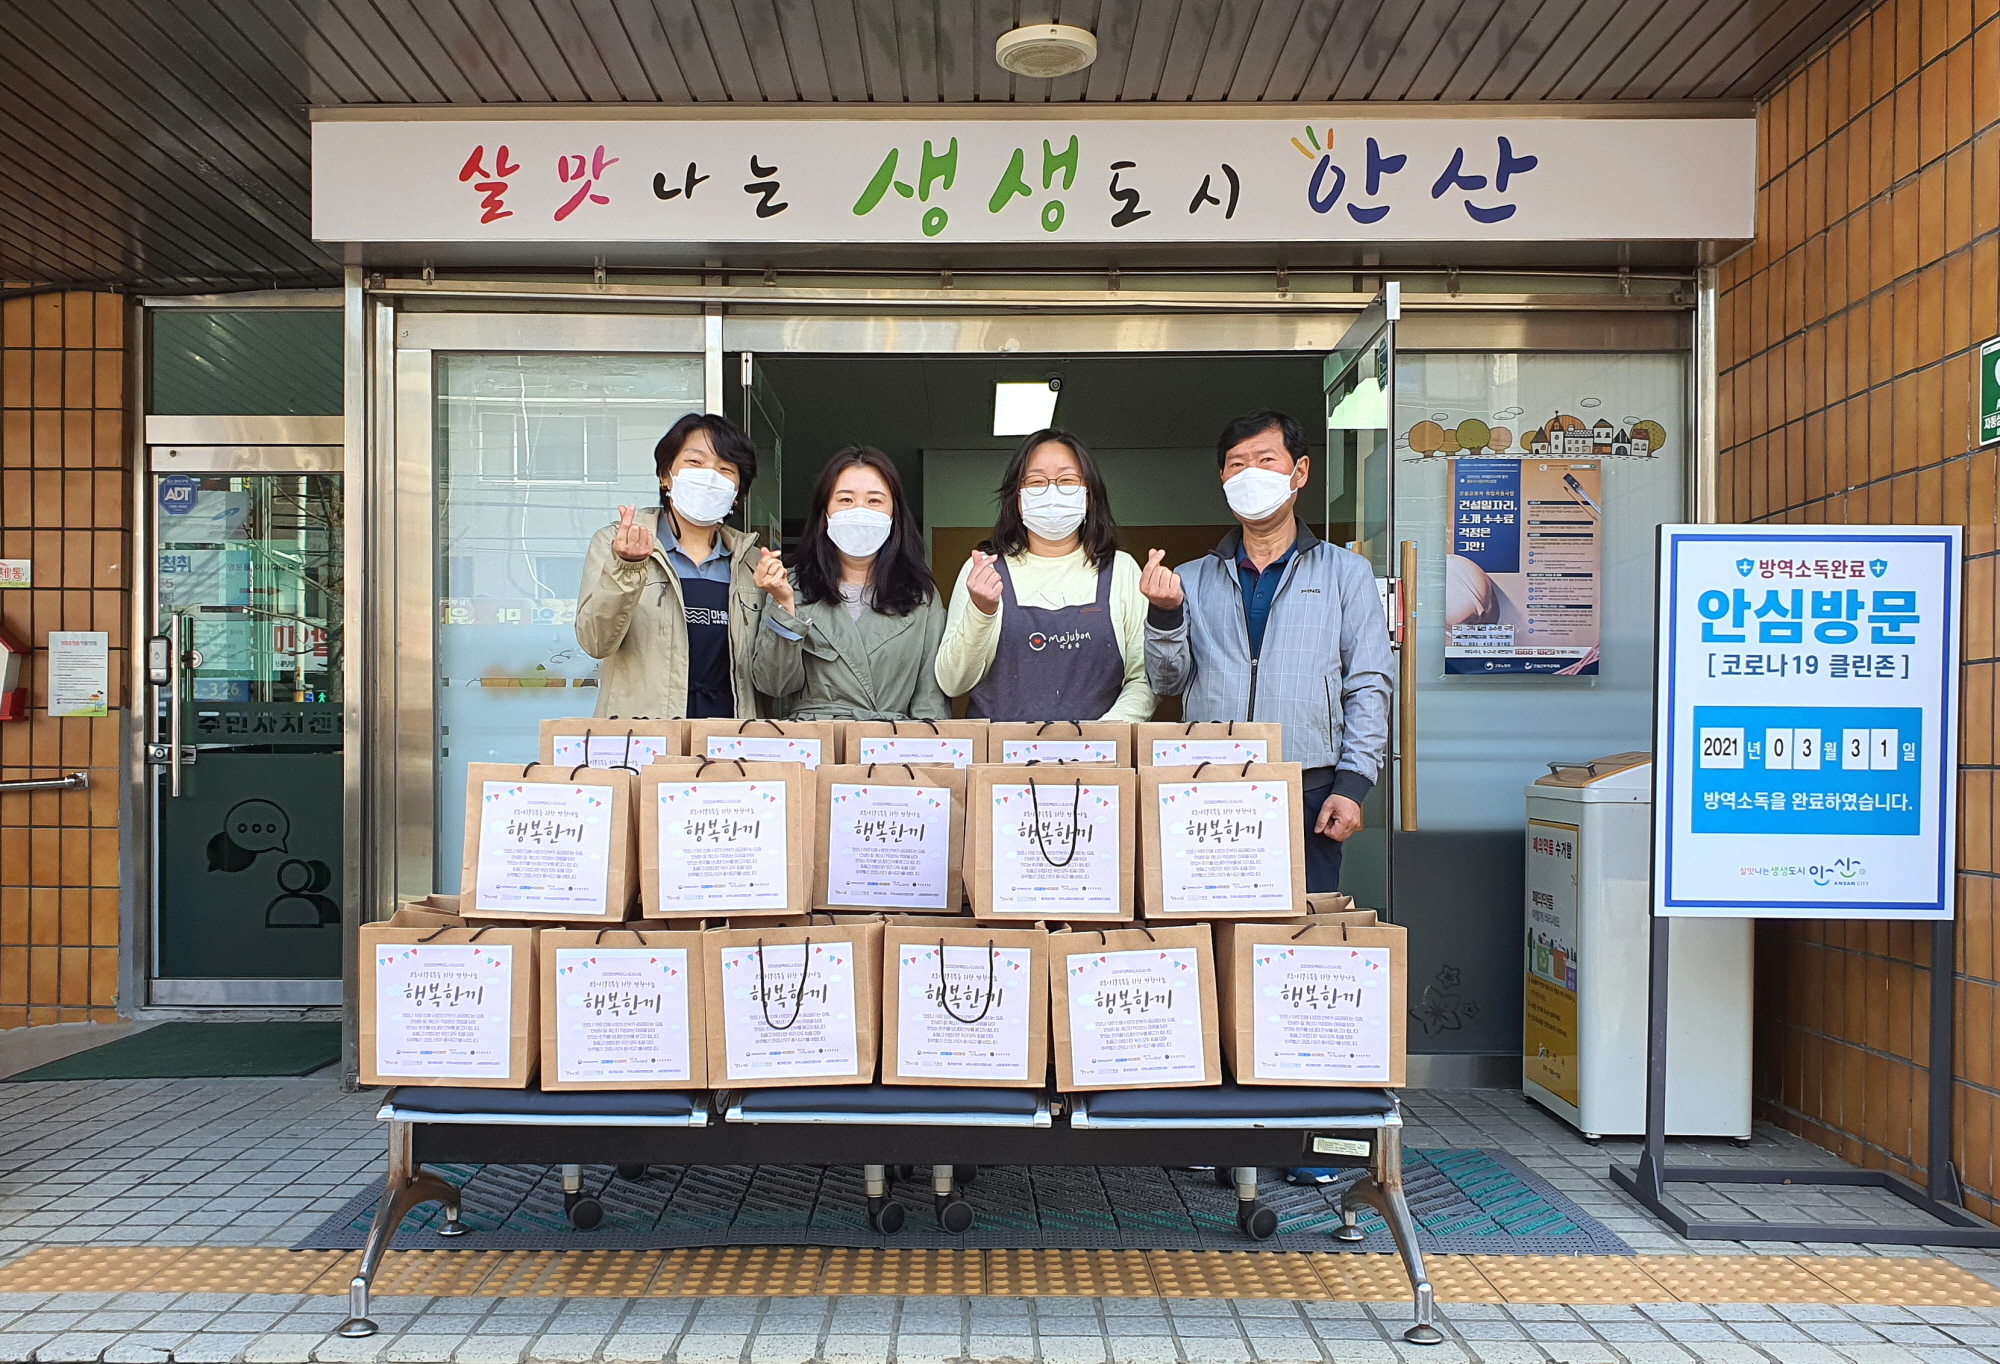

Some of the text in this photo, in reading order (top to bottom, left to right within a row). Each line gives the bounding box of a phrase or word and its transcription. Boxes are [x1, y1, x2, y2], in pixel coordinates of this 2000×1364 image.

[164, 487, 191, 501] ADT
[1459, 500, 1518, 511] 건설일자리,
[1459, 513, 1514, 524] 소개 수수료
[1458, 541, 1485, 551] 그만!
[1758, 558, 1866, 579] 방역소독완료
[1697, 588, 1920, 645] 안심방문
[1049, 628, 1091, 644] majubon
[1704, 737, 1739, 757] 2021
[1747, 742, 1761, 760] 년
[1824, 742, 1837, 761] 월
[1903, 743, 1916, 761] 일
[1703, 791, 1913, 812] 방역소독을 완료하였습니다.
[506, 819, 583, 844] 행복한끼
[684, 819, 759, 843] 행복한끼
[854, 820, 925, 843] 행복한끼
[1186, 819, 1262, 843] 행복한끼
[403, 983, 483, 1007] 행복한끼
[583, 992, 660, 1016] 행복한끼
[1095, 989, 1172, 1014] 행복한끼
[1280, 984, 1361, 1009] 행복한끼
